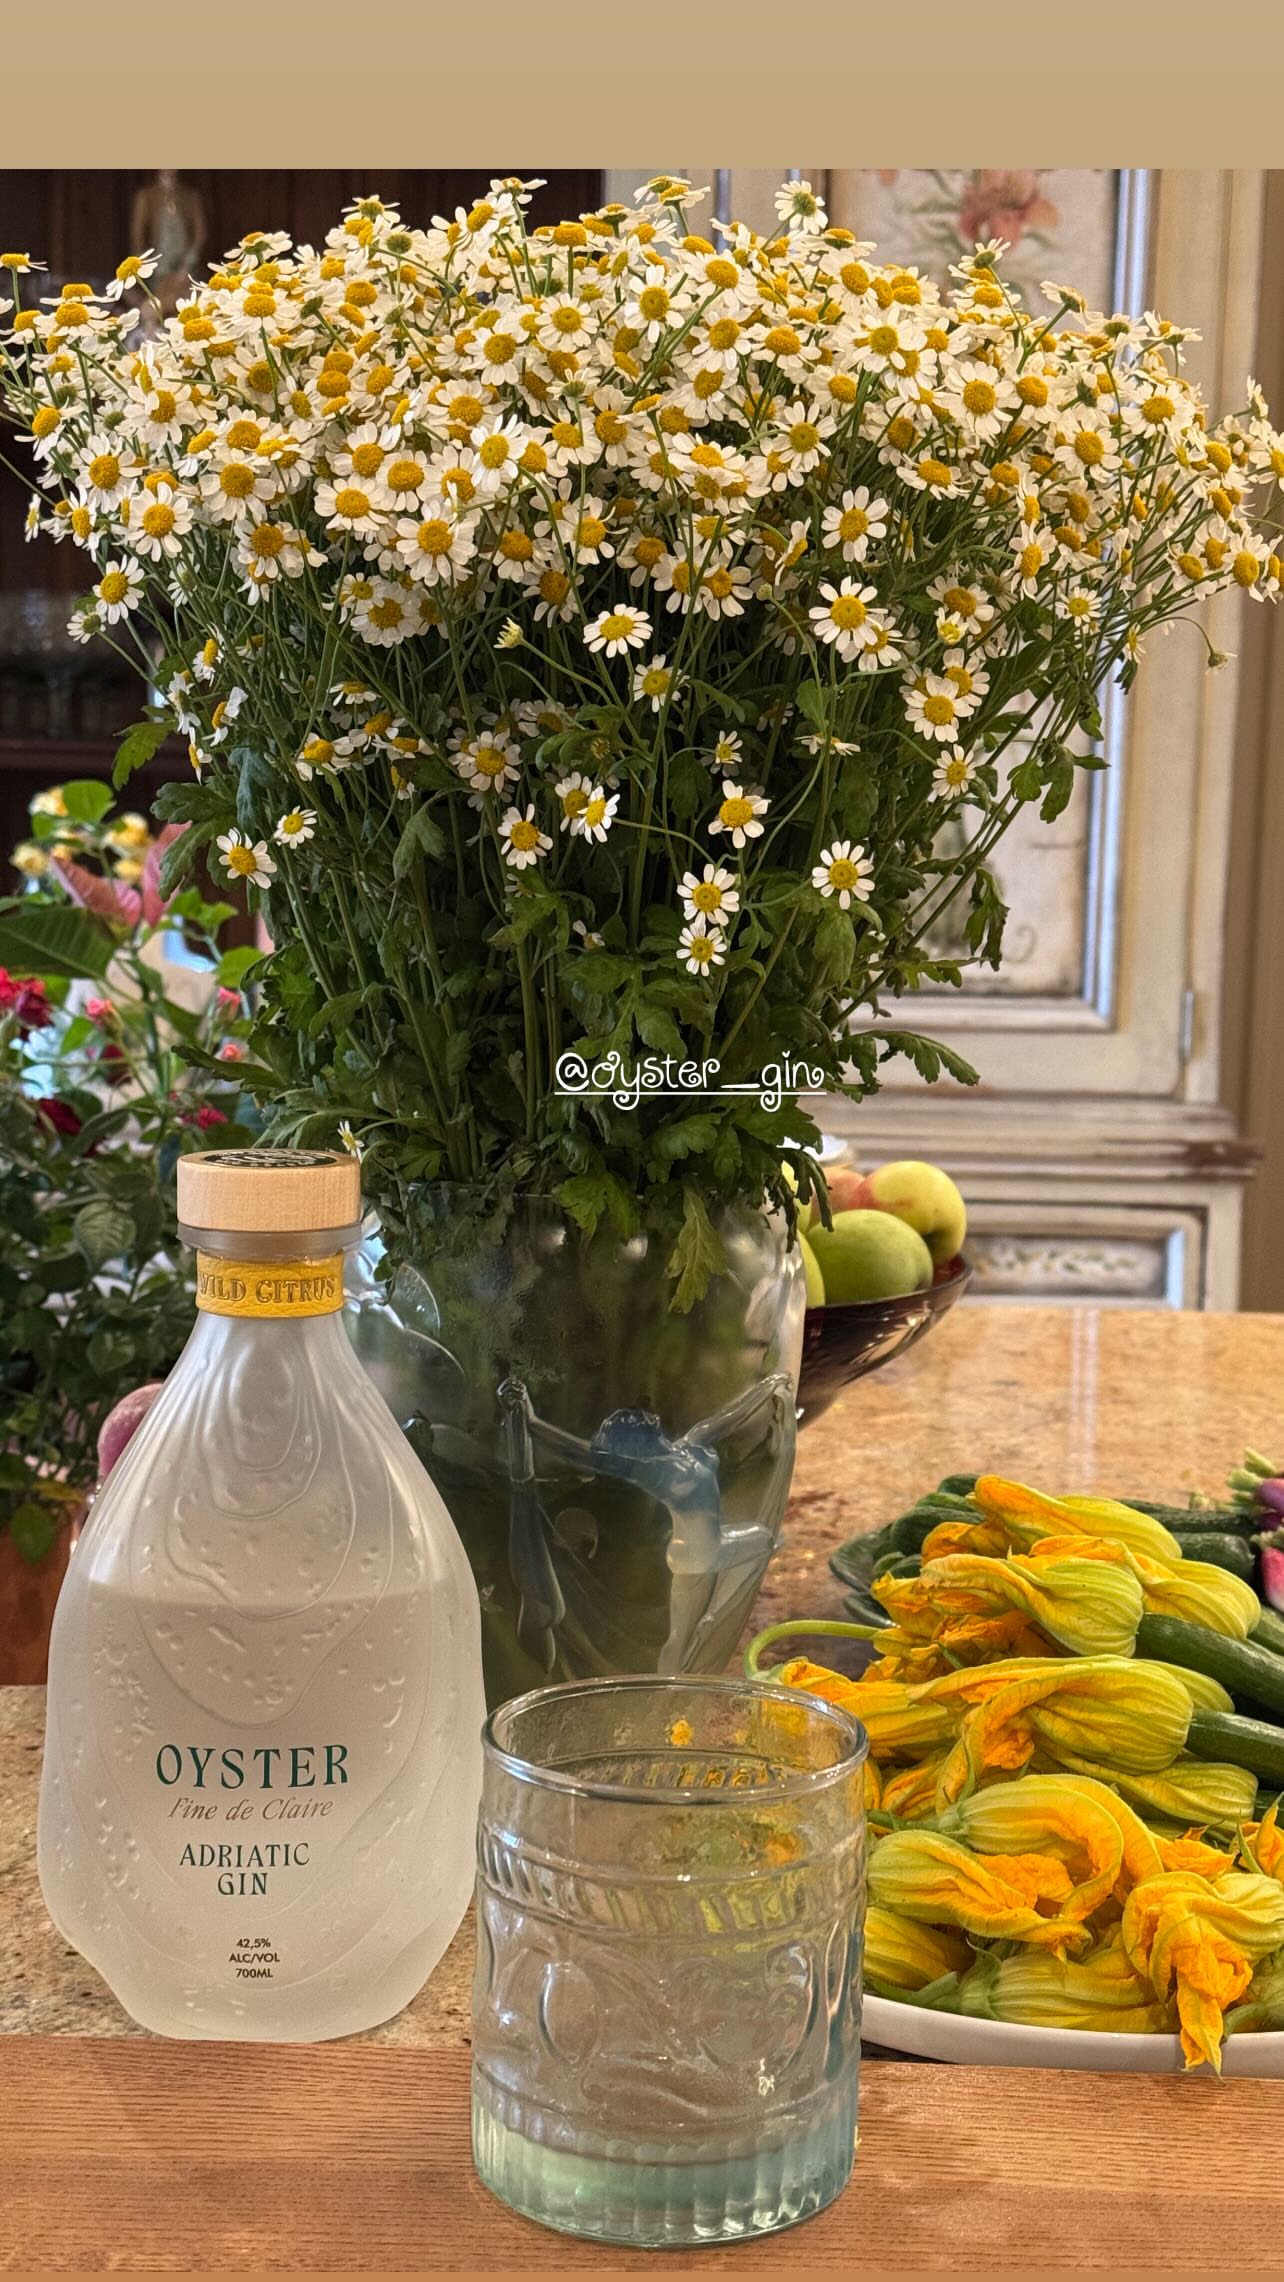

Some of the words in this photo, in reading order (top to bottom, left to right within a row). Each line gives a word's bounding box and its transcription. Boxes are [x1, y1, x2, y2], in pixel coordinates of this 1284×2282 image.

[255, 1278, 336, 1303] CITRUS
[156, 1744, 349, 1790] OYSTER
[168, 1797, 218, 1821] Fine
[225, 1799, 254, 1821] de
[262, 1796, 334, 1820] Claire
[179, 1843, 311, 1868] ADRIATIC
[217, 1872, 269, 1896] GIN
[236, 1938, 271, 1950] 42,5%
[228, 1952, 281, 1964] ALC/VOL
[235, 1967, 273, 1979] 700ML
